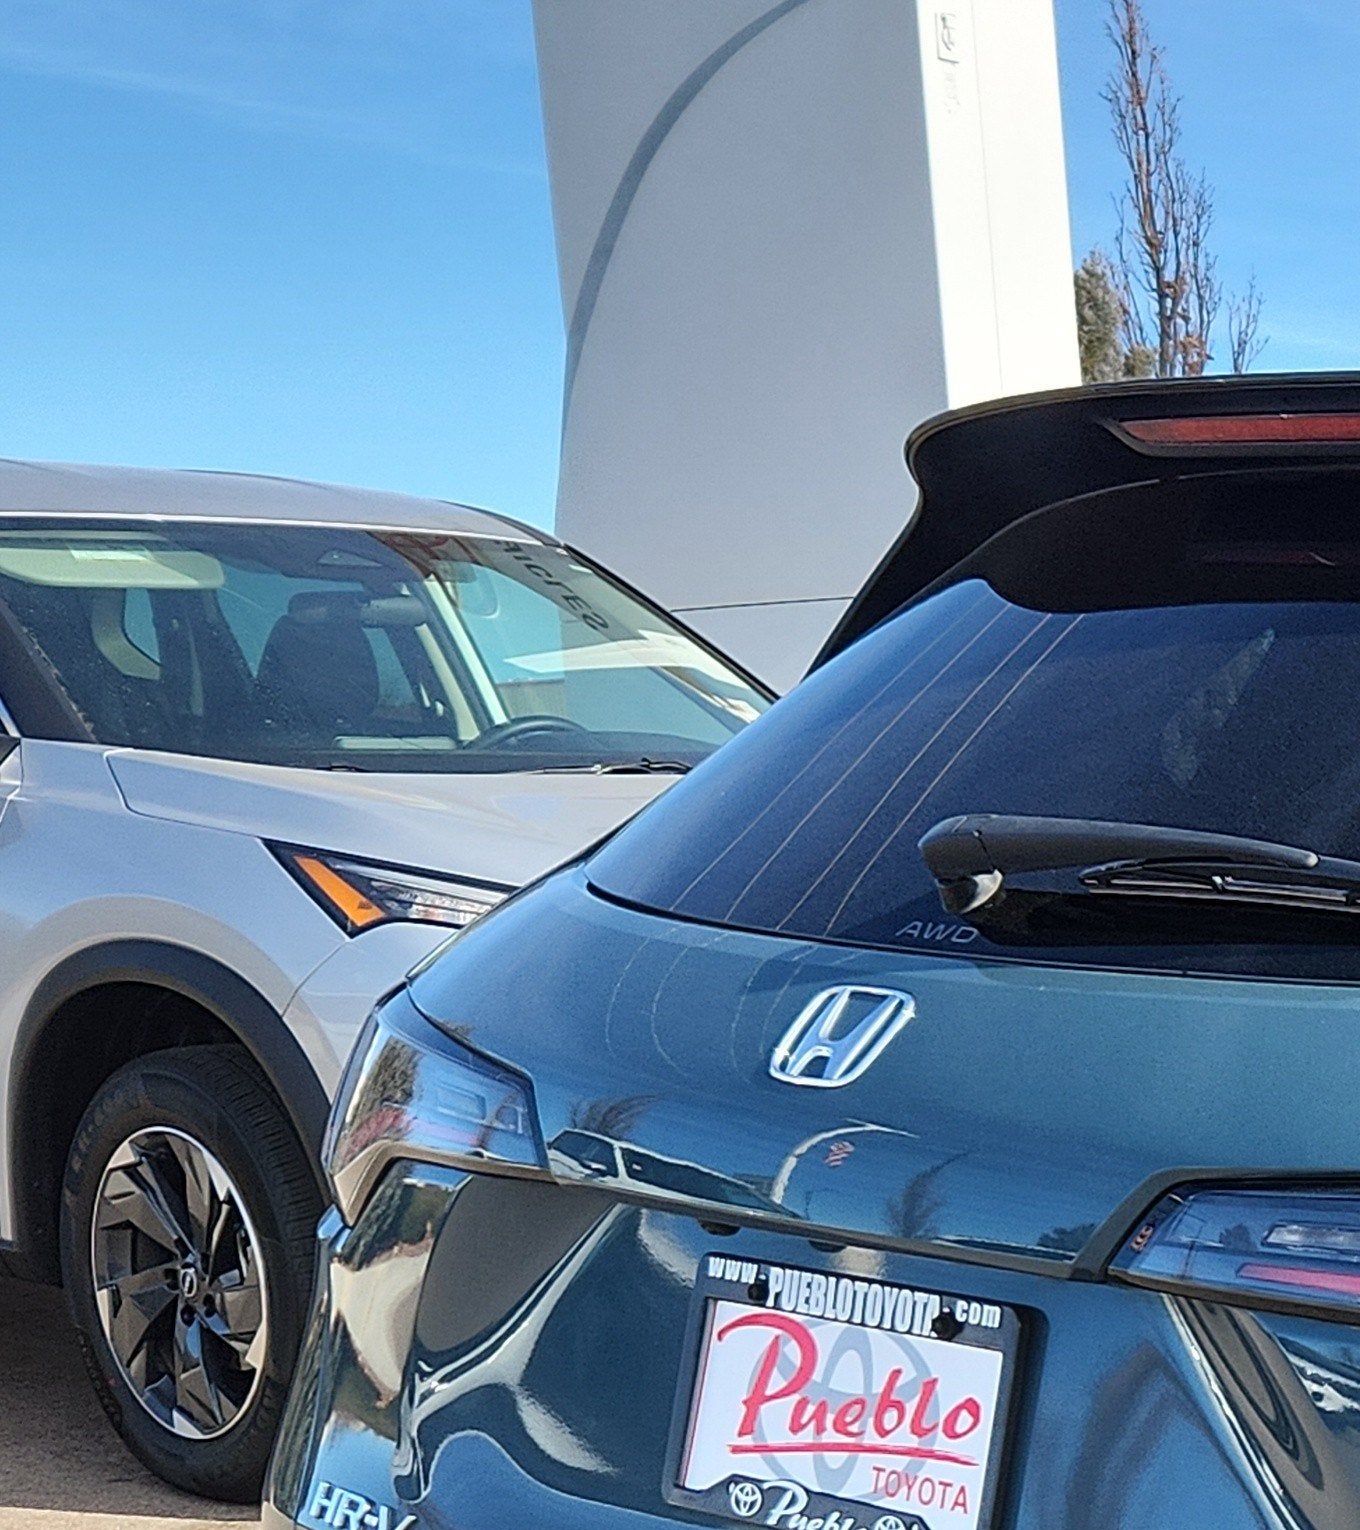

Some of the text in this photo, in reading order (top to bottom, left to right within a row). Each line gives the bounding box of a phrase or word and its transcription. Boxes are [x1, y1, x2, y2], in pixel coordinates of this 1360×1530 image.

[895, 920, 980, 943] AWD
[716, 1312, 982, 1440] Pueblo
[871, 1466, 969, 1515] TOYOTA
